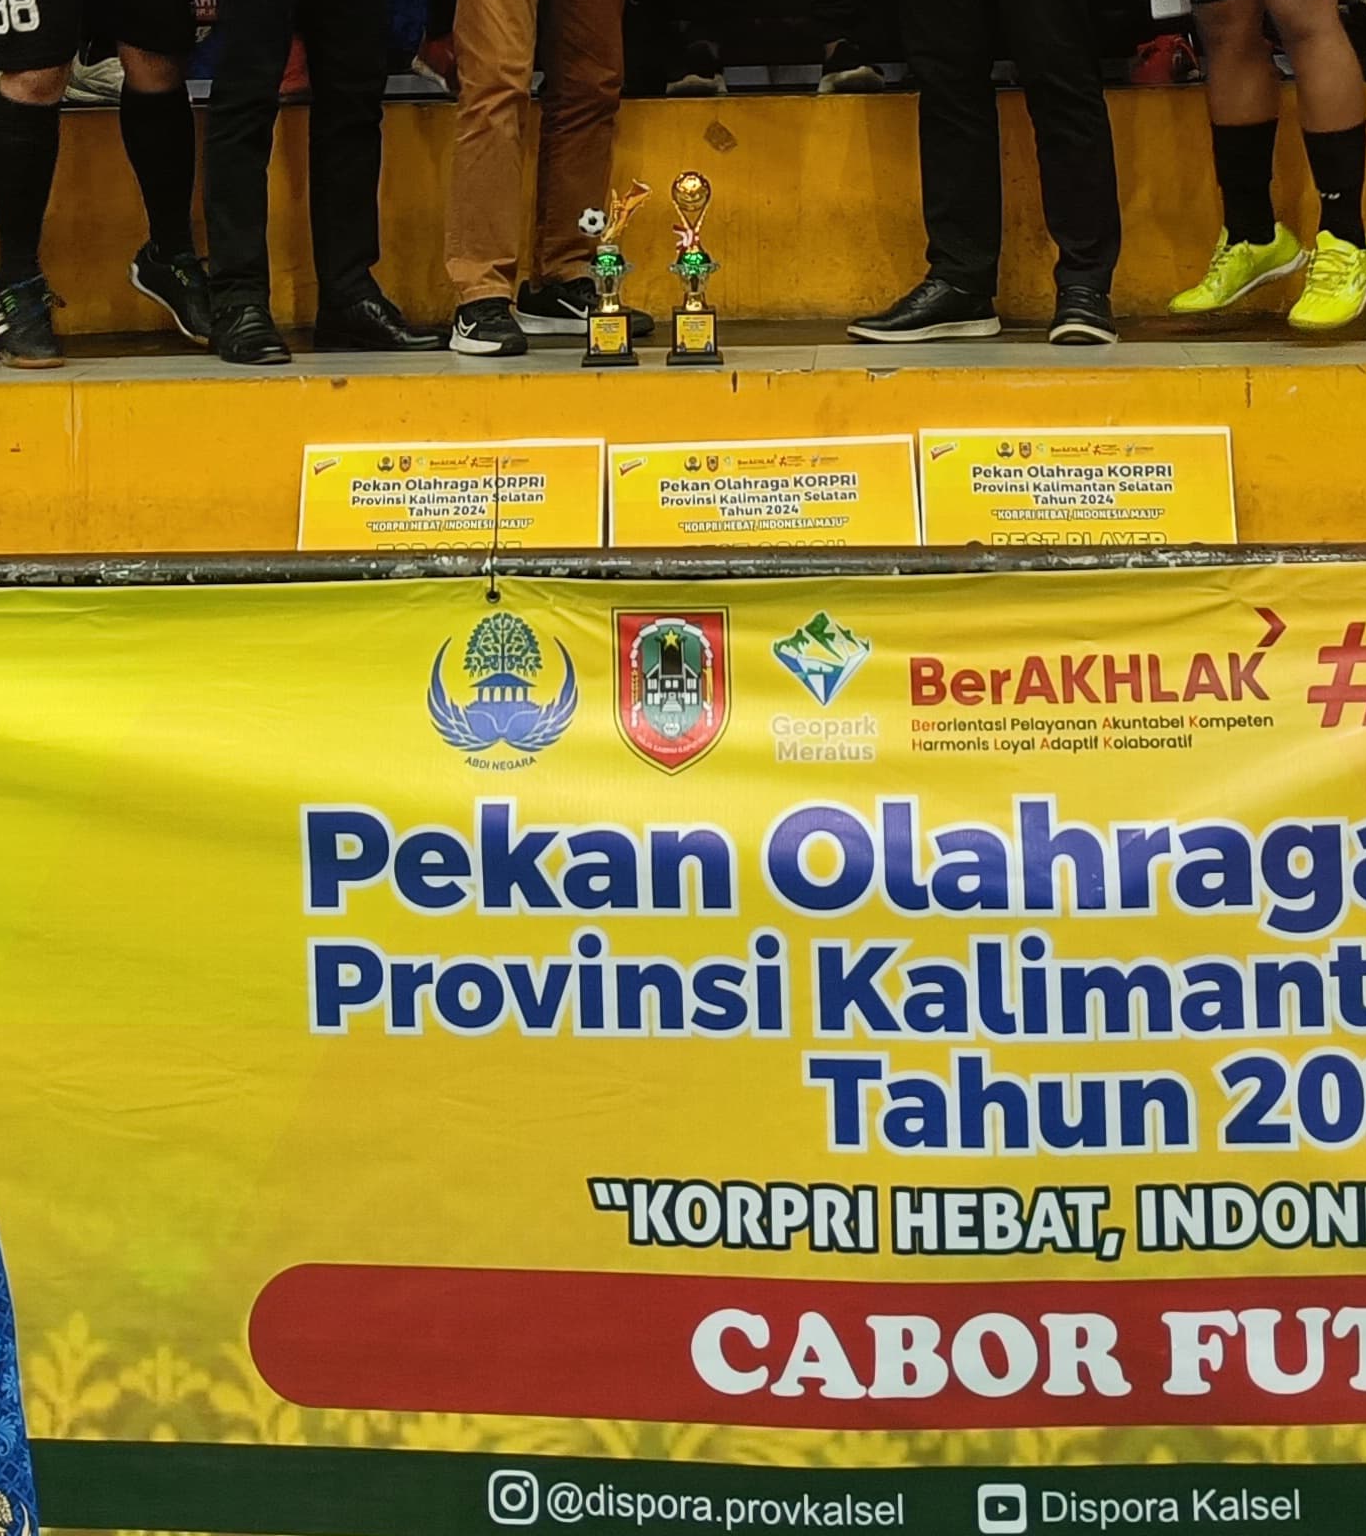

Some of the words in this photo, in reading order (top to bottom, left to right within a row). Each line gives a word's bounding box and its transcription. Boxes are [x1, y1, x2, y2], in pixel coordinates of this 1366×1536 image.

[660, 479, 710, 492] Pekan
[715, 478, 789, 492] Olahraga
[793, 474, 856, 487] KORPRI
[972, 466, 1023, 478] Pekan
[1027, 466, 1104, 480] Olahraga
[1108, 465, 1172, 478] KORPRI
[352, 479, 401, 492] Pekan
[405, 478, 479, 493] Olahraga
[483, 476, 545, 489] KORPRI
[974, 481, 1029, 492] Provinsi
[1033, 481, 1117, 492] Kalimantan
[1119, 481, 1172, 492] Selatan
[352, 494, 406, 505] Provinsi
[410, 493, 489, 504] Kalimantan
[492, 493, 543, 503] Selatan
[661, 496, 716, 506] Provinsi
[720, 492, 801, 504] Kalimantan
[804, 490, 856, 502] Selatan
[1033, 495, 1077, 505] Tahun
[1080, 494, 1114, 505] 2024
[409, 506, 450, 517] Tahun
[453, 505, 486, 515] 2024
[720, 506, 763, 517] Tahun
[766, 504, 799, 515] 2024
[910, 652, 1270, 706] BerAKHLAK
[772, 713, 876, 740] Geopark
[911, 717, 1007, 733] Berorientasi
[1010, 717, 1097, 735] Pelayanan
[1102, 715, 1184, 730] Akuntabel
[1189, 714, 1274, 731] Kompeten
[776, 739, 874, 761] Meratus
[911, 737, 989, 752] Harmonis
[993, 736, 1035, 755] Loyal
[1040, 736, 1099, 754] Adaptif
[1103, 734, 1192, 750] Kolaboratif
[464, 756, 490, 770] ABDI
[490, 755, 536, 771] NEGARA
[305, 802, 733, 910] Pekan
[314, 934, 783, 1031] Provinsi
[808, 1055, 1191, 1149] Tahun
[895, 1187, 1125, 1260] HEBAT,
[691, 1308, 1132, 1399] CABOR
[545, 1483, 905, 1529] @dispora.provkalsel
[1041, 1490, 1180, 1525] Dispora
[1192, 1488, 1301, 1522] Kalsel
